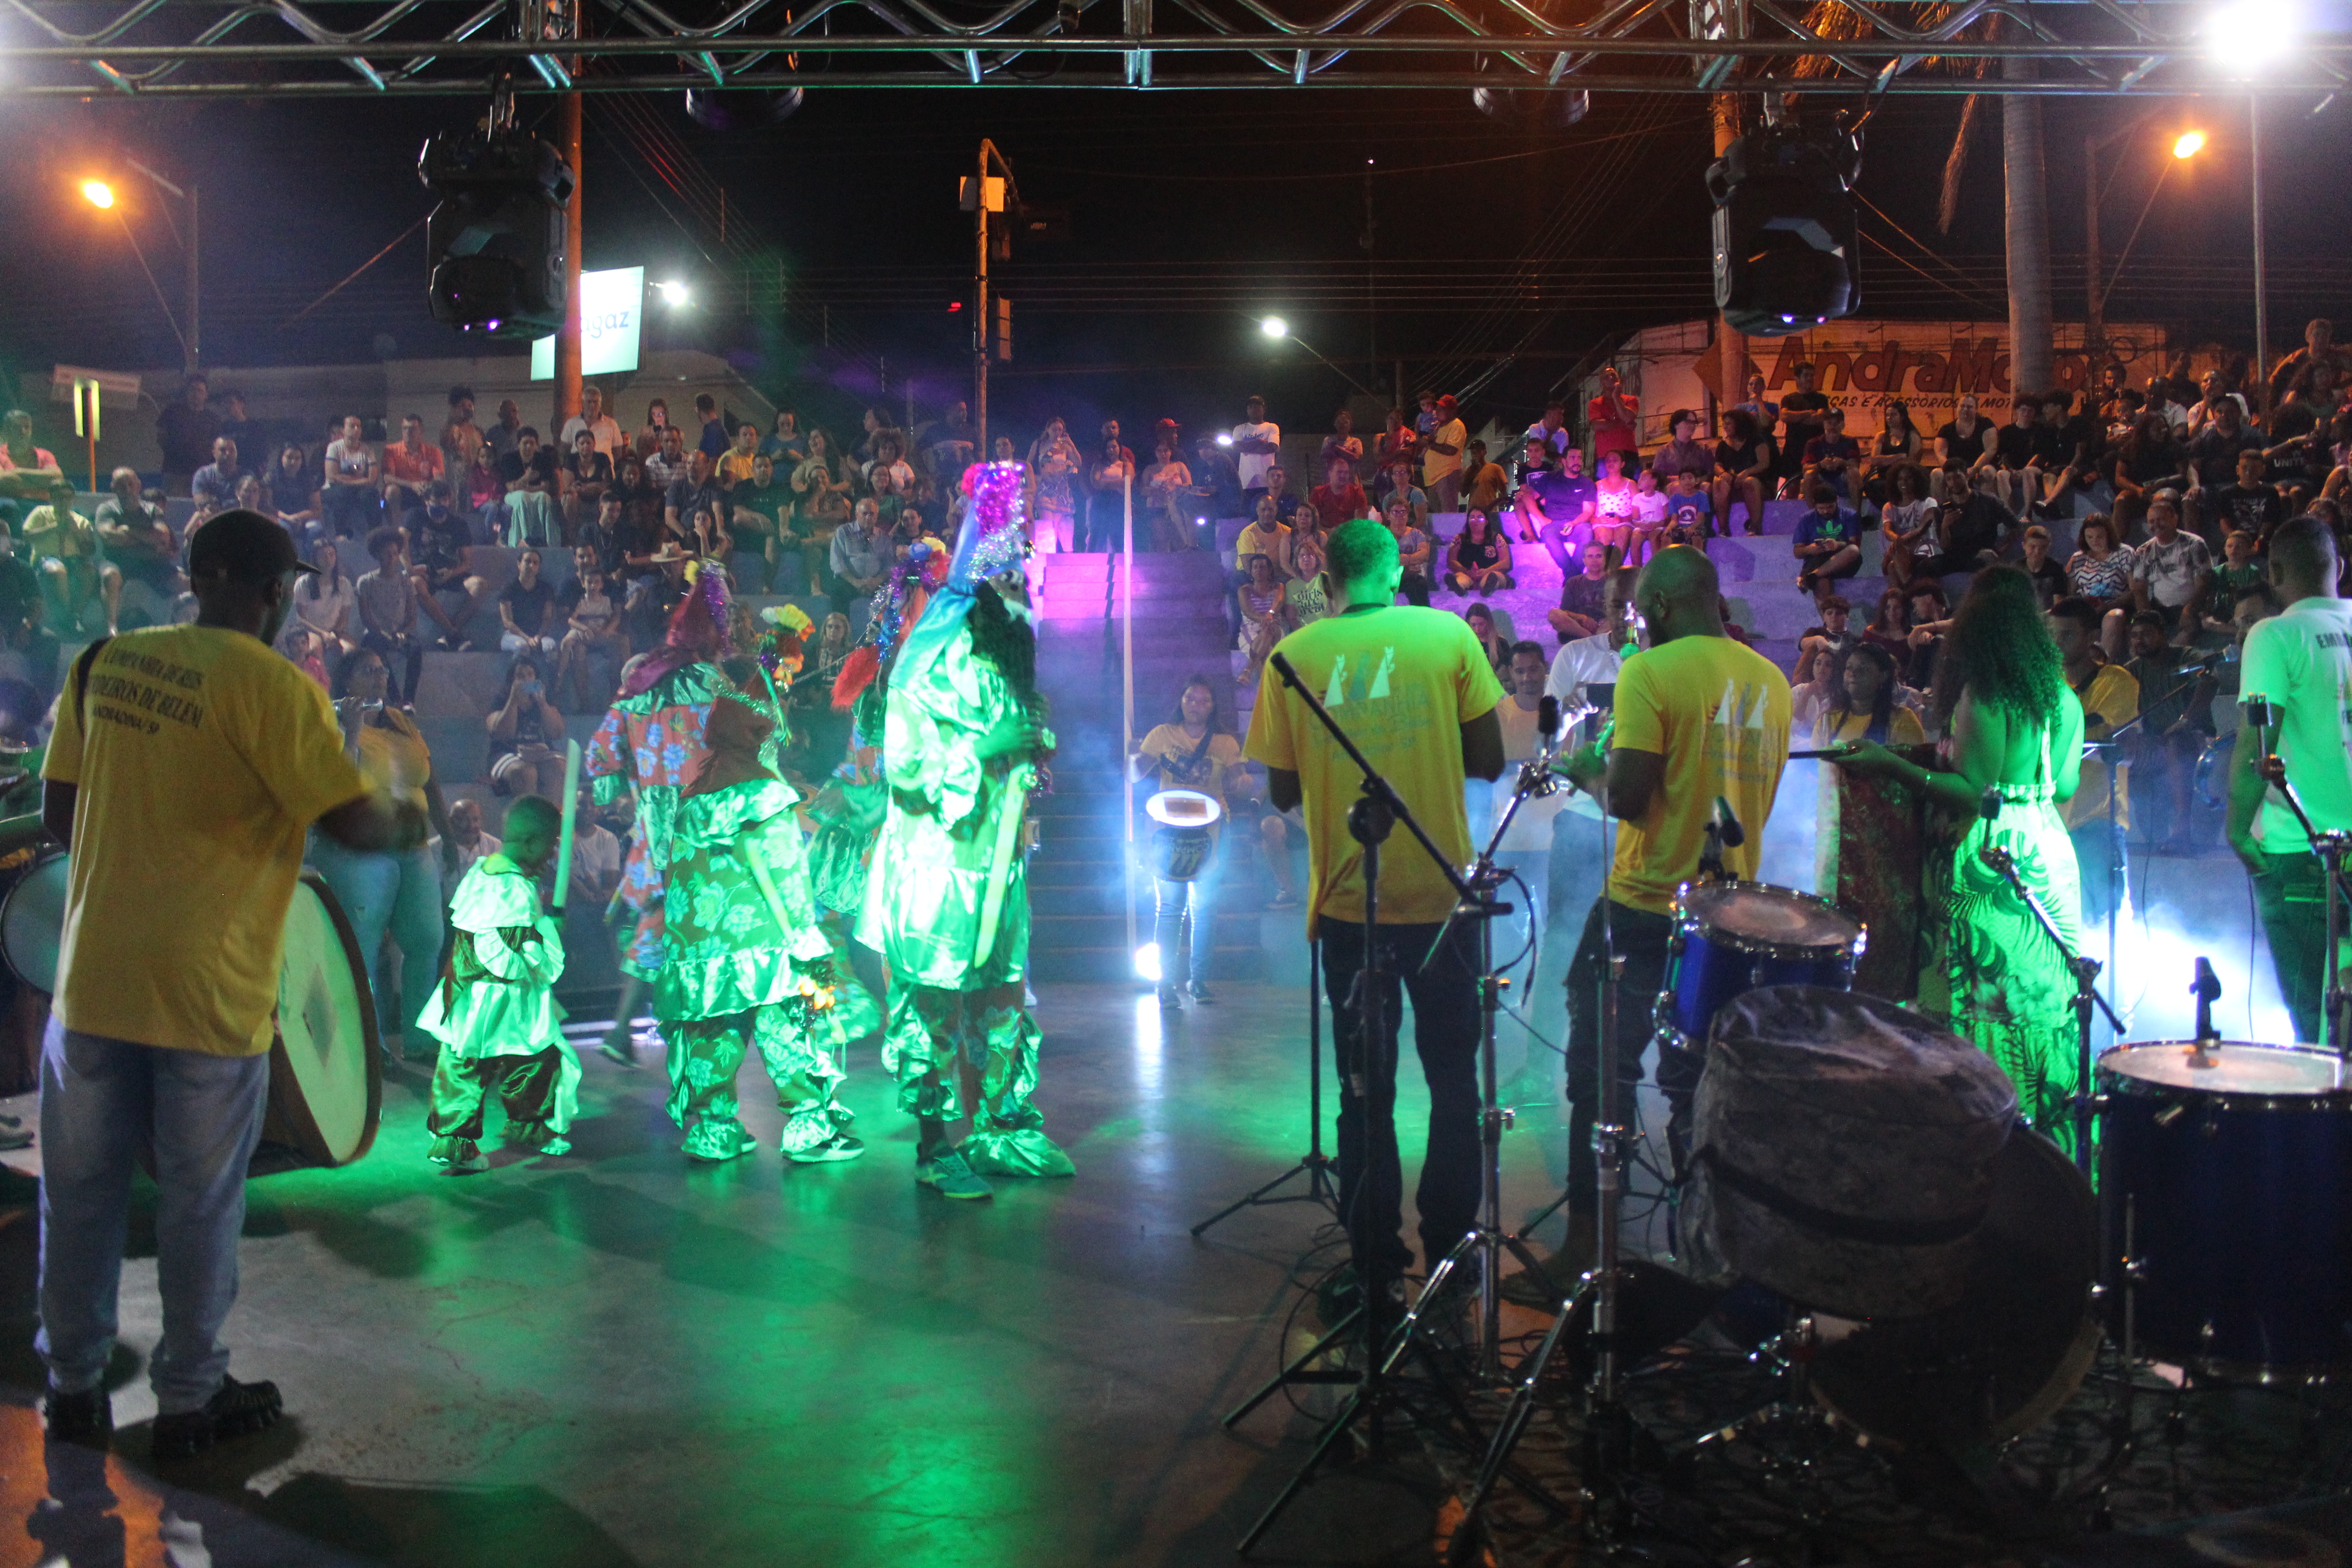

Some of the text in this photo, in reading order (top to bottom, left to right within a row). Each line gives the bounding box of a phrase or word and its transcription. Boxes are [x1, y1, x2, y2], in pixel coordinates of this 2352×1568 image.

[581, 310, 629, 339] agaz
[1767, 336, 2086, 393] AndraMoo
[1980, 397, 2010, 408] MOT
